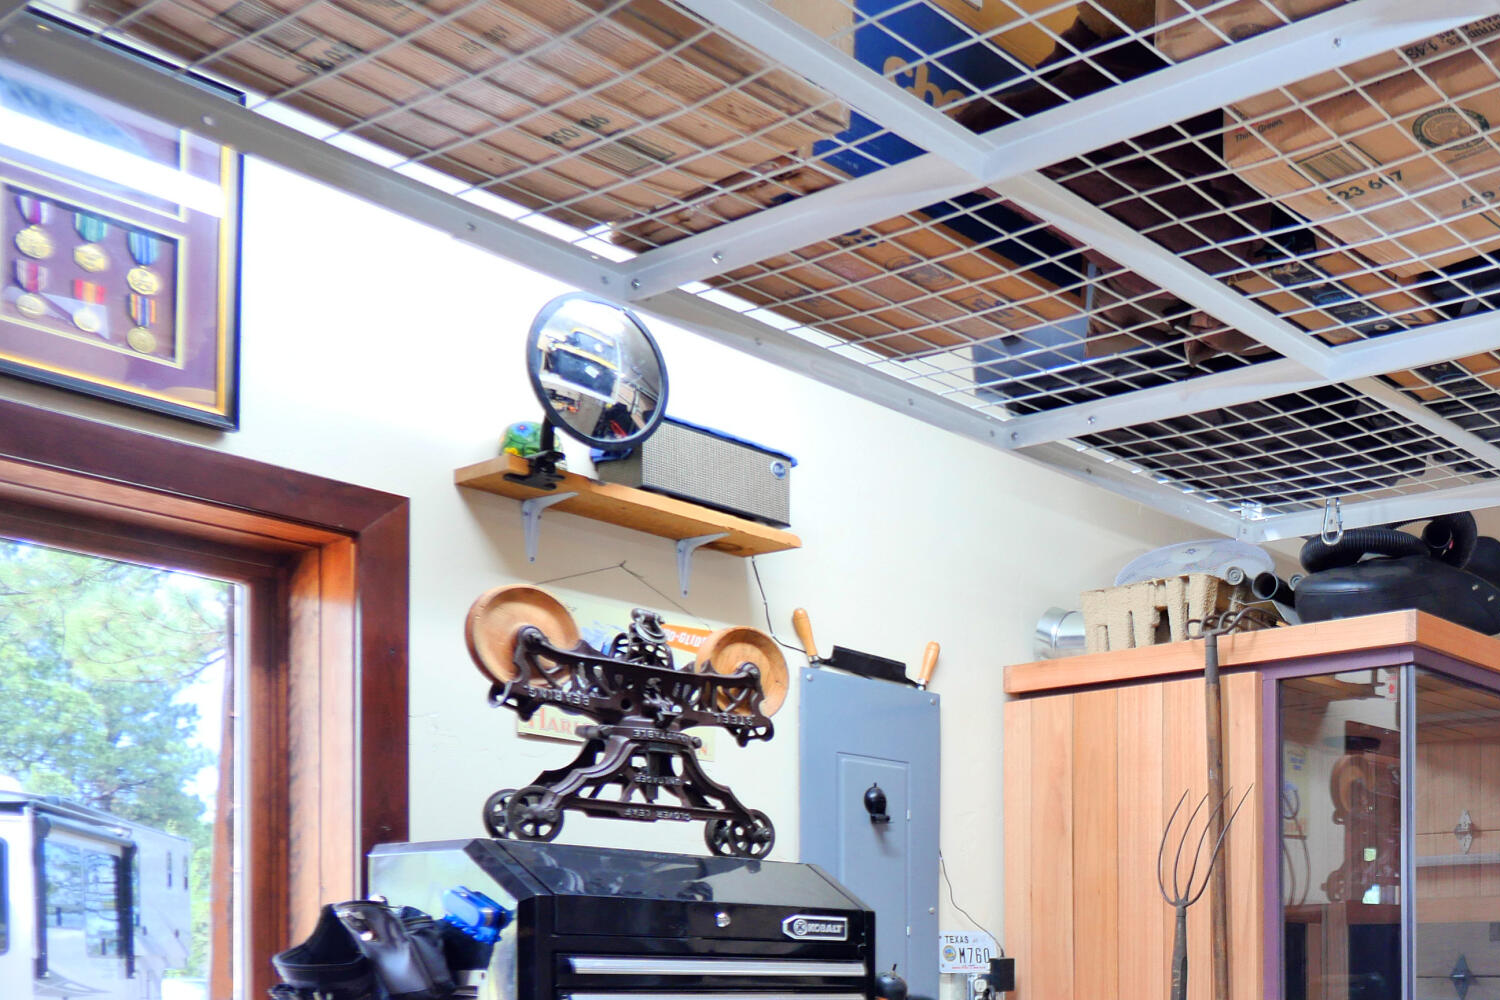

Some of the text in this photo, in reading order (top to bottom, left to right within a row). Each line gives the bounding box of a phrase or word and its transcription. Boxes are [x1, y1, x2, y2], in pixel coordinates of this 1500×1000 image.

[527, 687, 590, 706] BEARING
[714, 712, 756, 725] STEEL
[807, 922, 844, 934] KOBALT
[944, 935, 969, 944] TEXAS
